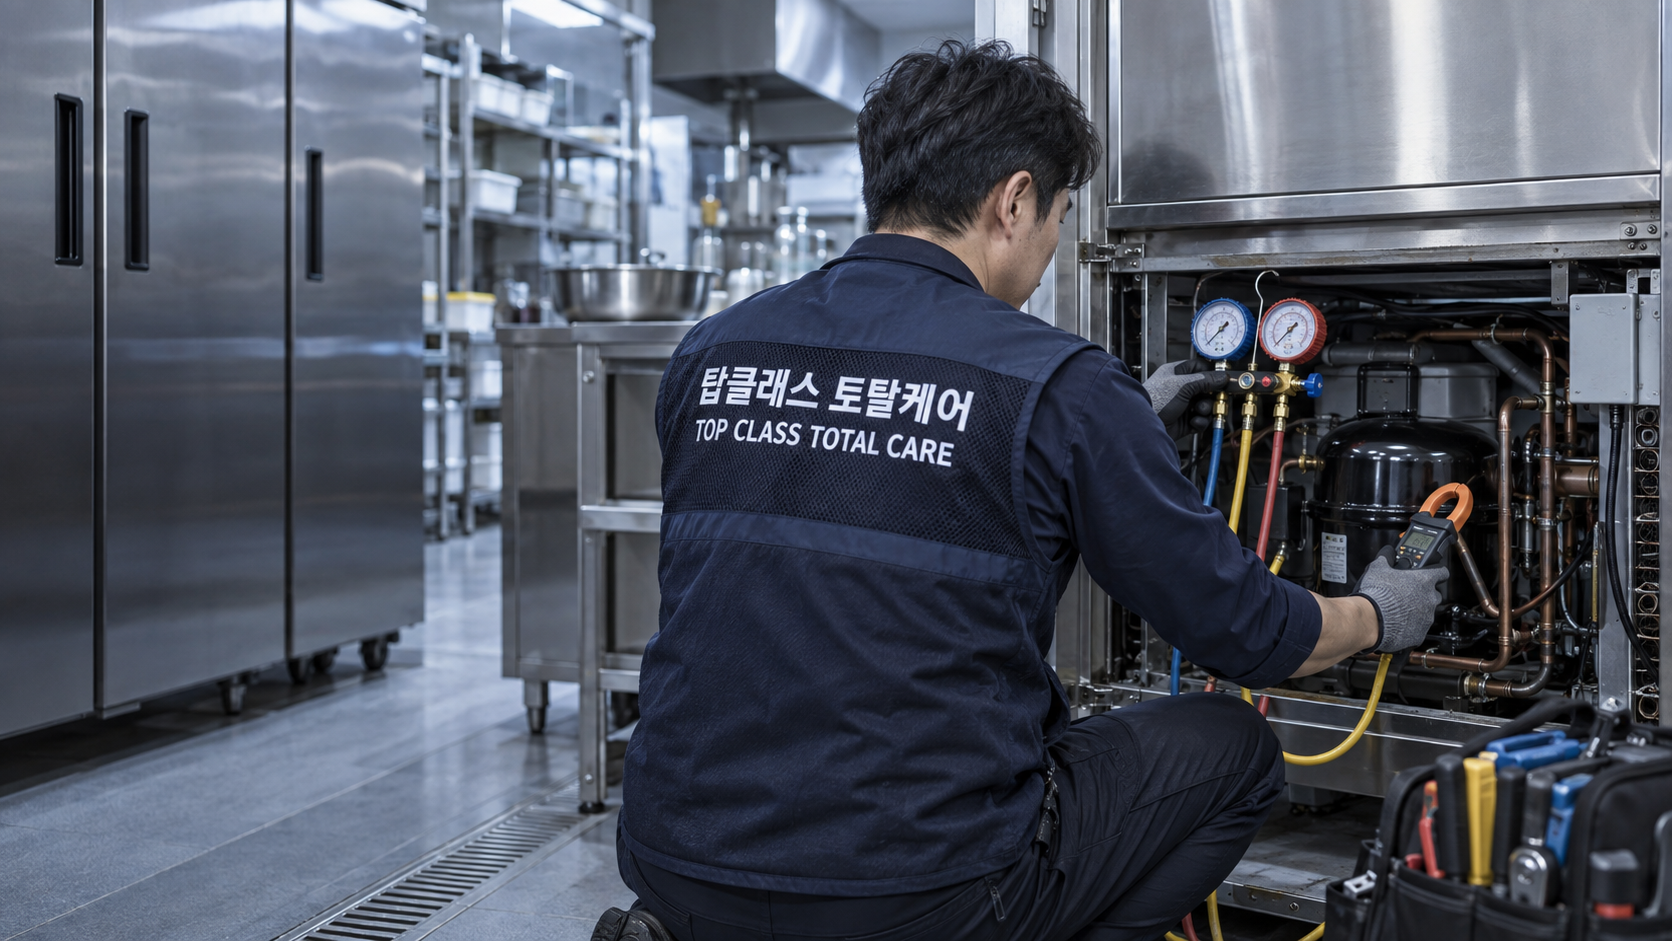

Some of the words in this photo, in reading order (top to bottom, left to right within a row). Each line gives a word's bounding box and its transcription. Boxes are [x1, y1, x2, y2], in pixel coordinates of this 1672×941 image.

[699, 366, 820, 408] 탑클래스
[828, 376, 974, 432] 토탈케어
[695, 418, 728, 442] TOP
[733, 419, 802, 446] CLASS
[810, 425, 879, 455] TOTAL
[886, 434, 955, 467] CARE
